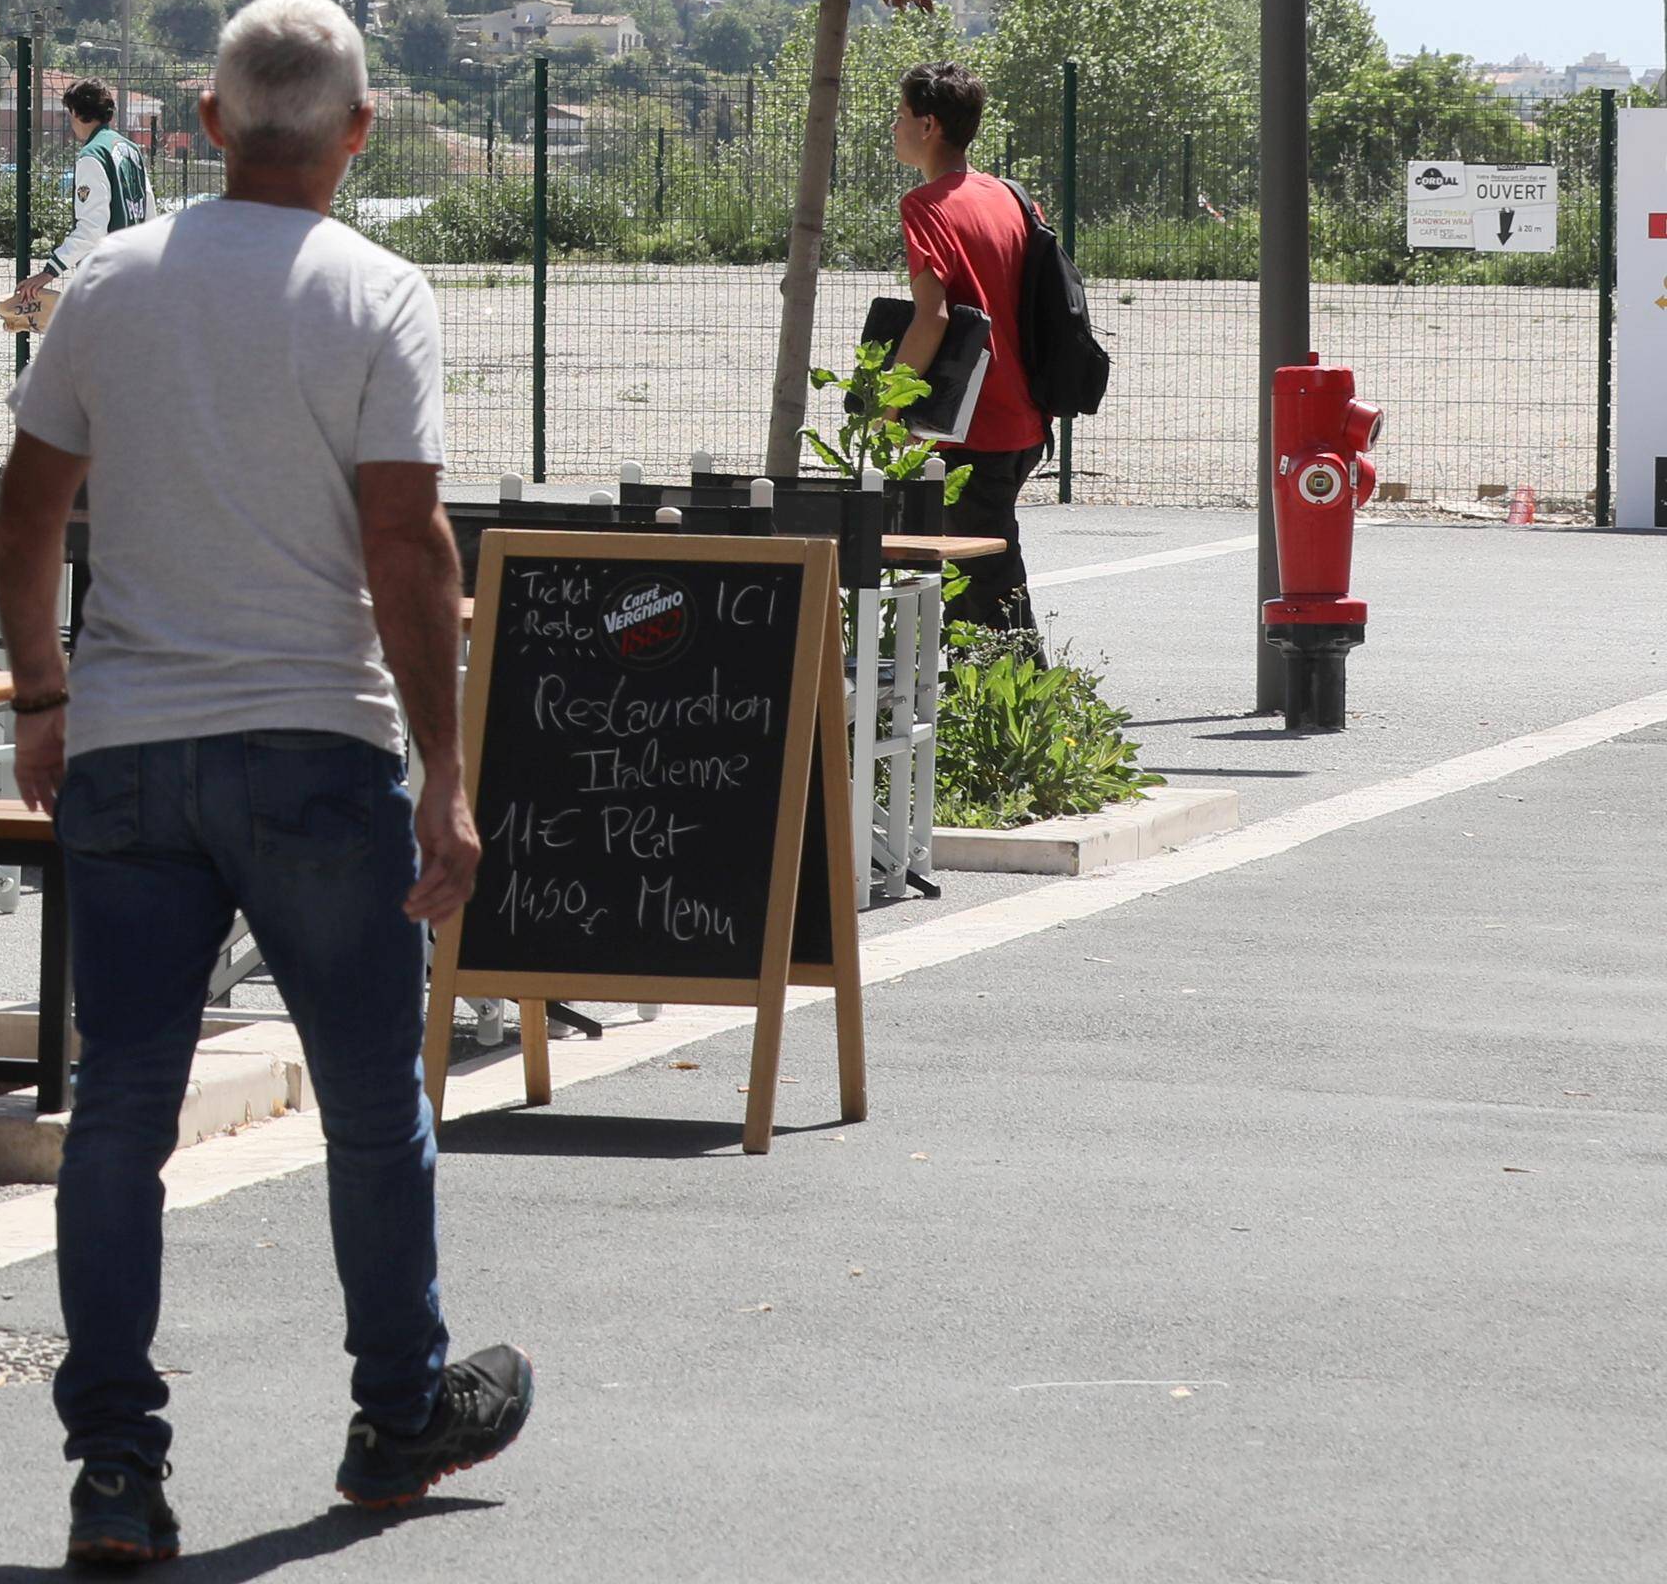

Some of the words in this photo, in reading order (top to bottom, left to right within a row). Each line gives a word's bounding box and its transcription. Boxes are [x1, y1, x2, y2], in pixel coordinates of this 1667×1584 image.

[1415, 175, 1459, 186] CORDIAL
[1477, 184, 1547, 200] OUVERT
[1413, 218, 1451, 226] SANDWICH
[1419, 227, 1438, 236] CAFÉ
[1518, 224, 1523, 233] à
[14, 301, 42, 315] KFC
[621, 583, 662, 611] CAFFÈ
[603, 590, 684, 634] VERGNANO
[619, 610, 683, 656] 1882
[533, 666, 772, 738] Restauration
[570, 739, 750, 794] Italienne
[490, 802, 581, 864] 11€
[598, 805, 700, 860] Plat
[637, 876, 737, 945] Menu
